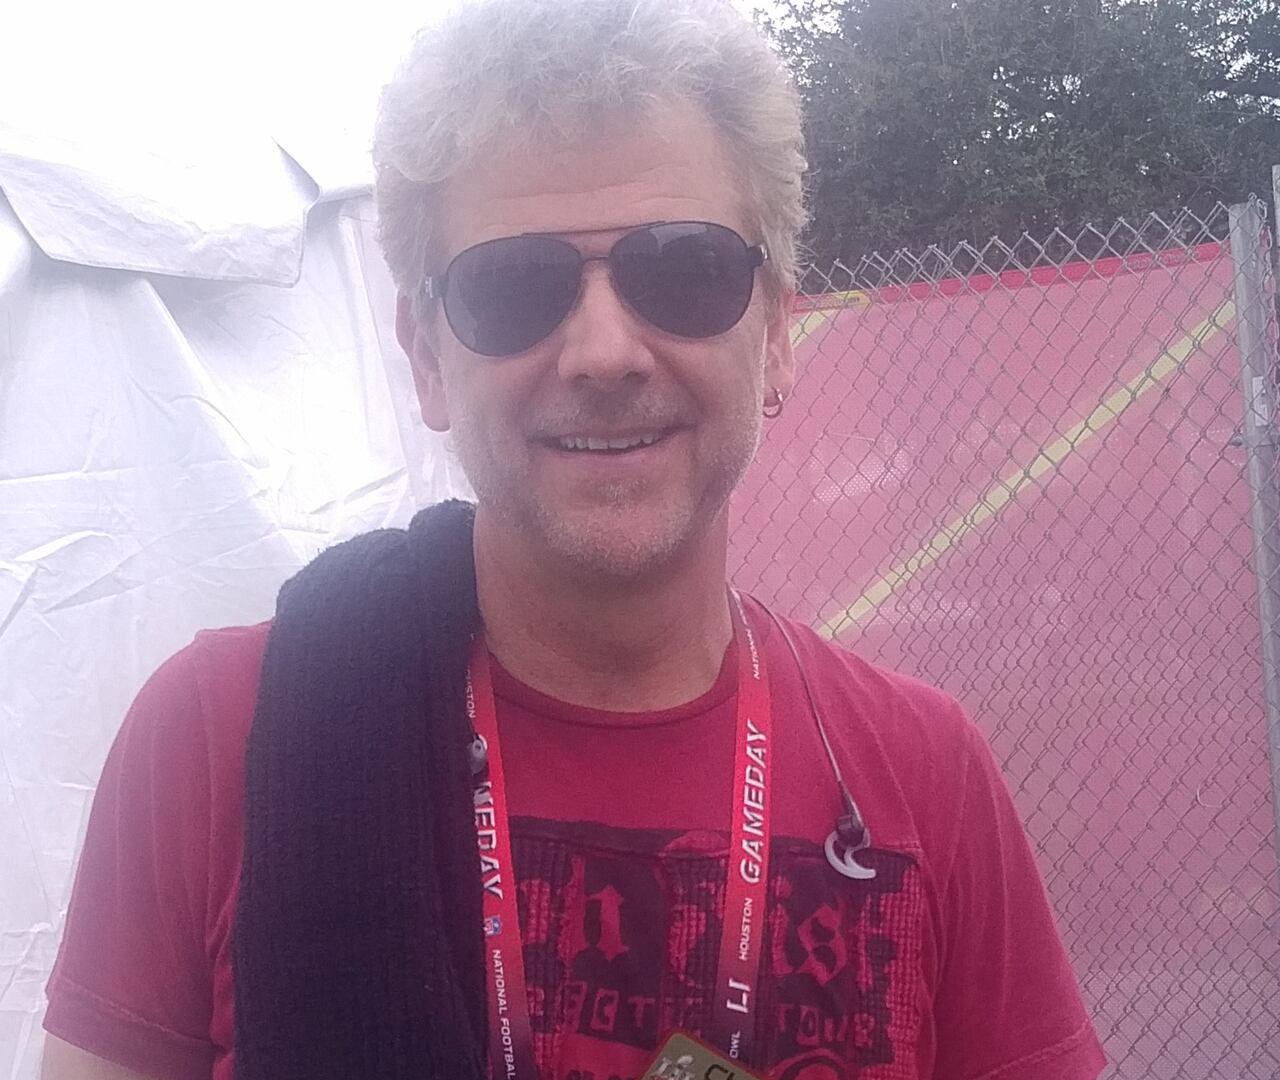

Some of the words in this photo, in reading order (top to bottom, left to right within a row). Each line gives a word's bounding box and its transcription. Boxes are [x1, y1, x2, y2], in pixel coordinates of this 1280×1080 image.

[473, 780, 504, 900] MEDAY
[739, 719, 767, 885] GAMEDAY
[491, 949, 507, 1015] NATIONAL
[729, 1030, 741, 1059] OWL
[738, 897, 753, 961] HOUSTON
